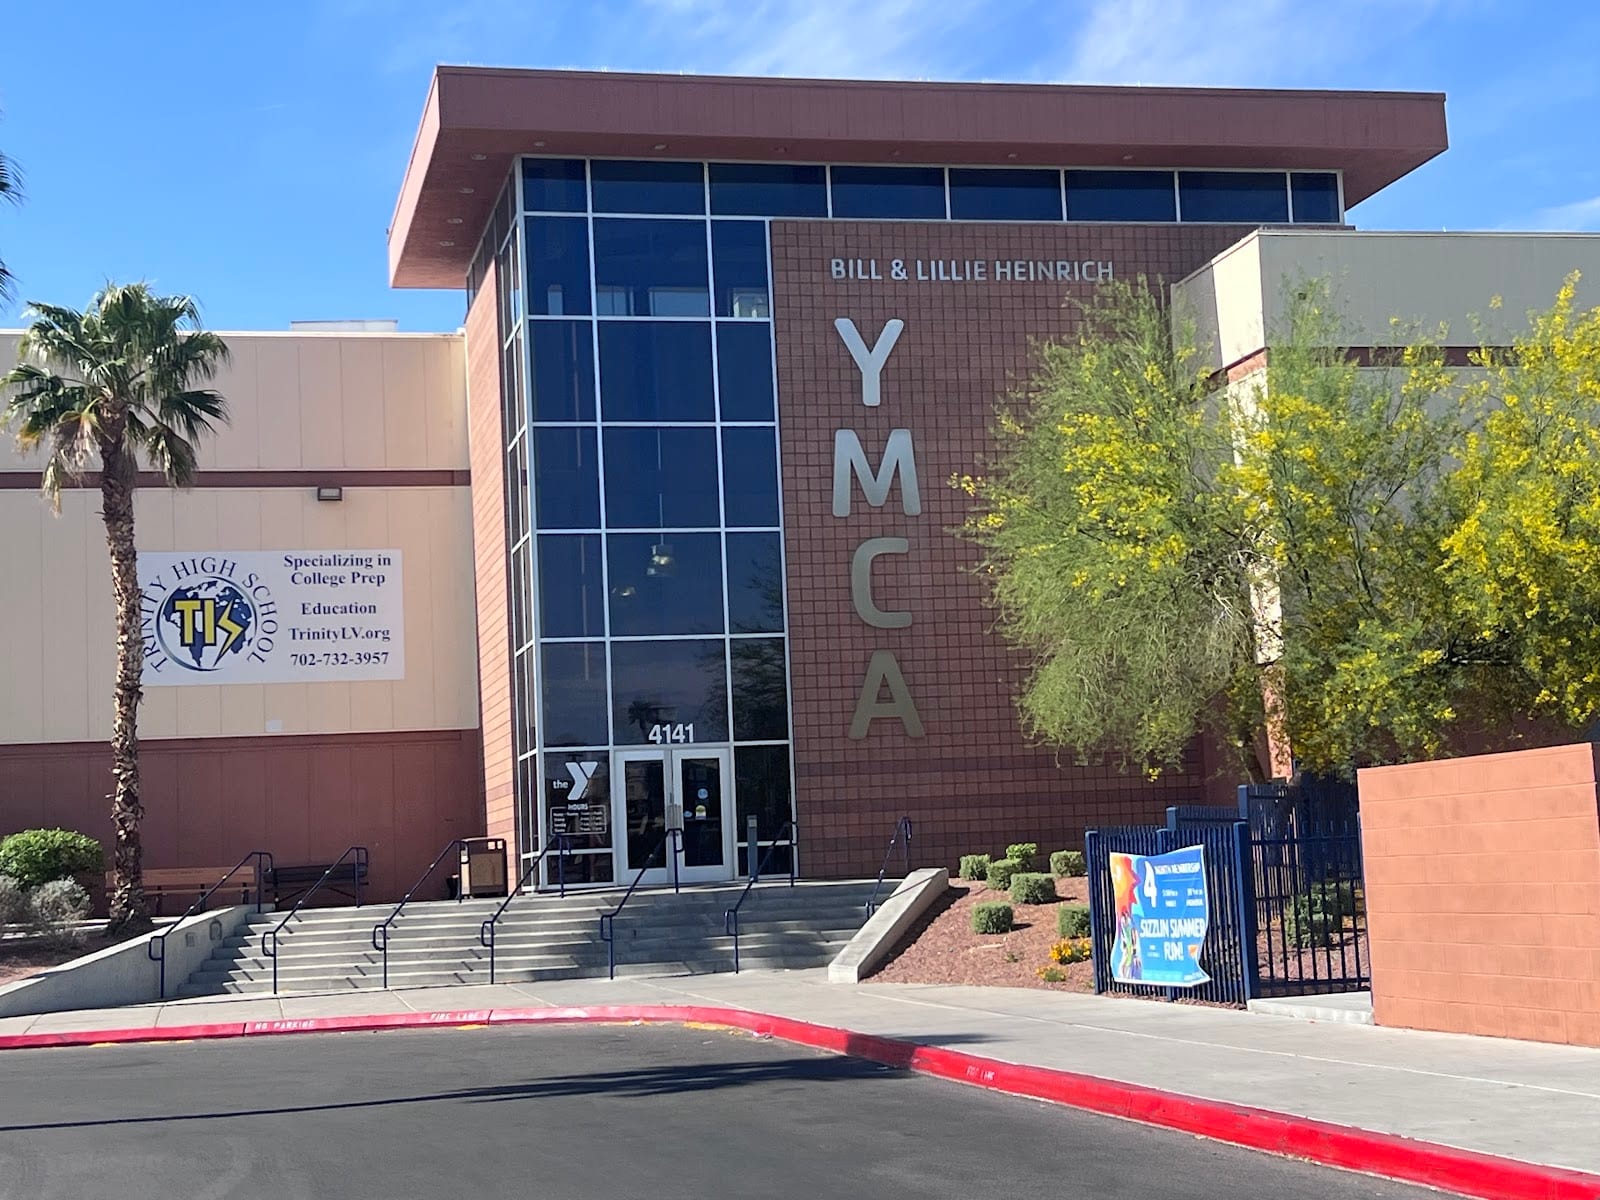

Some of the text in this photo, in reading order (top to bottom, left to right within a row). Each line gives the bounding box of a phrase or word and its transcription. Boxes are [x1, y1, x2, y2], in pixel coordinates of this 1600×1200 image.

[831, 258, 1114, 282] BILL & LILLIE HEINRICH
[832, 318, 925, 740] YMCA
[284, 553, 392, 569] Specializing in
[291, 572, 386, 587] College Prep
[171, 556, 237, 580] HIGH
[242, 572, 279, 664] SCHOOL
[301, 602, 377, 616] Education
[288, 627, 391, 643] TrinityLV.org
[290, 651, 389, 666] 702-732-3957
[648, 723, 695, 744] 4141
[552, 779, 569, 789] the
[1143, 861, 1158, 908] 4
[1169, 917, 1206, 938] SUMMER
[273, 1020, 315, 1029] PARKING
